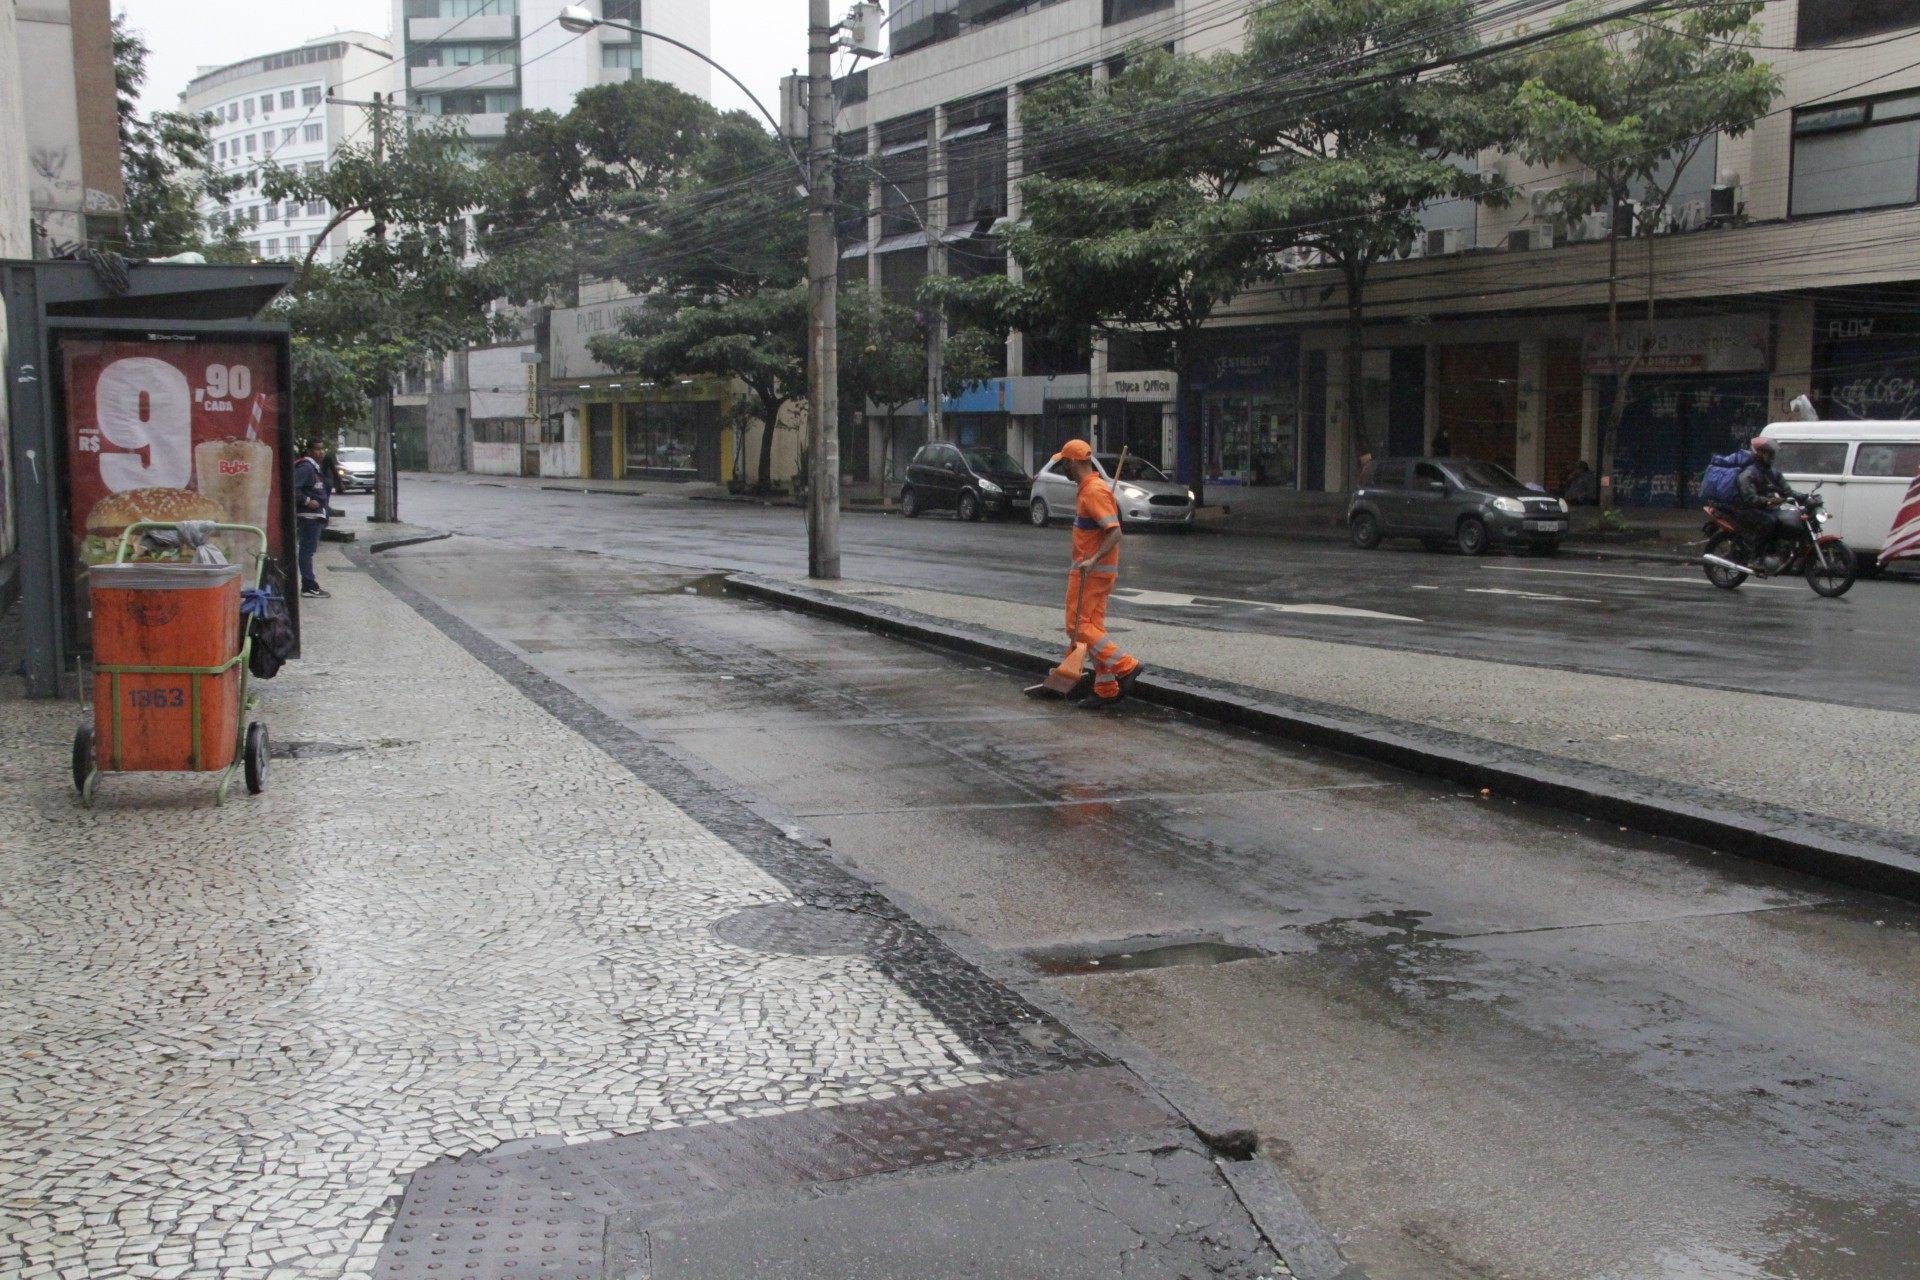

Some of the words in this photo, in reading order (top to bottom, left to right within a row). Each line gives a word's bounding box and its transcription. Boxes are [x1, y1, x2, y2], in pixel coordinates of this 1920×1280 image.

[1143, 379, 1170, 392] Office
[204, 400, 234, 412] CADA
[79, 435, 100, 453] R$
[217, 460, 251, 476] Bob's
